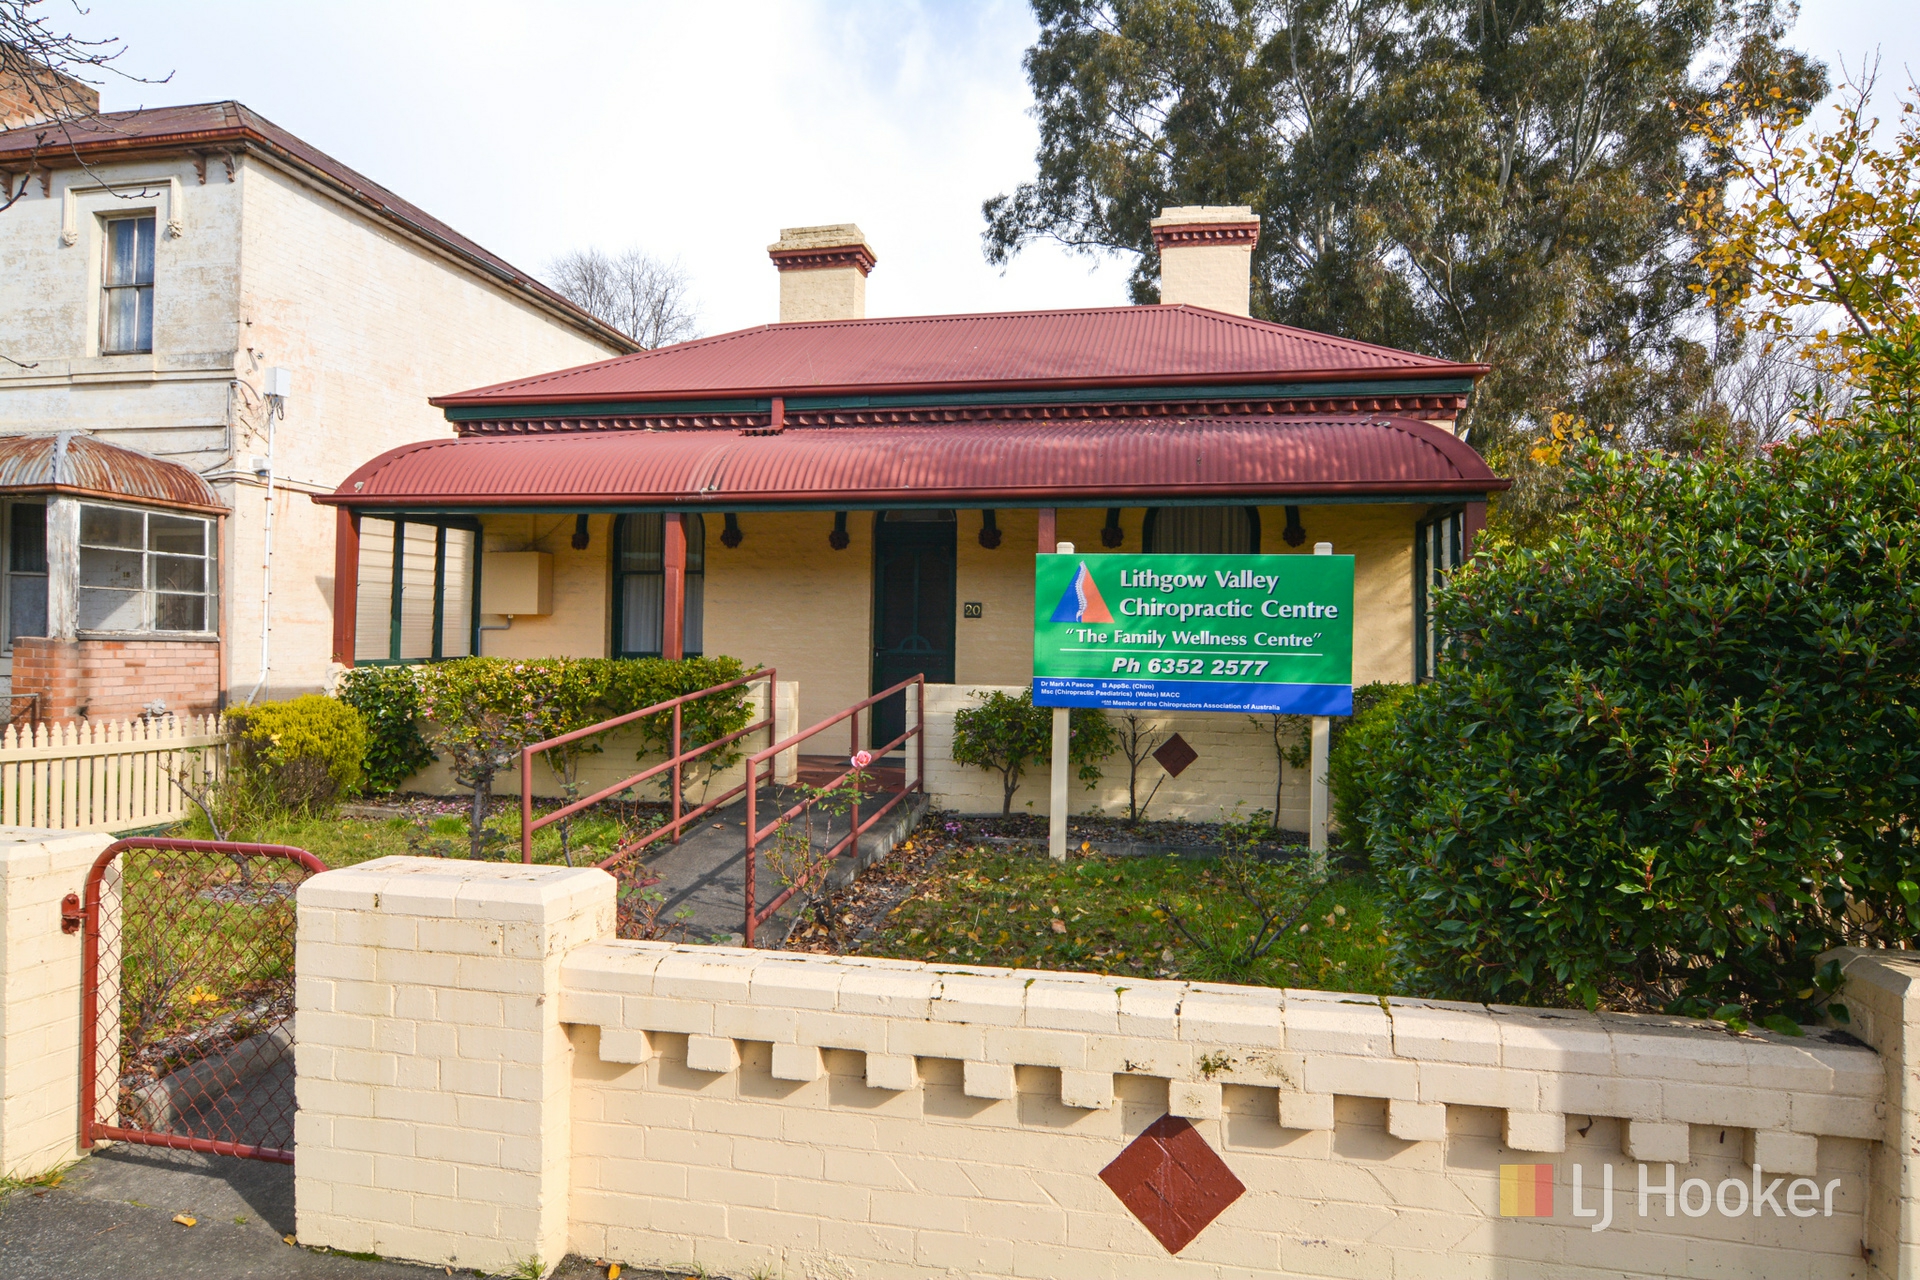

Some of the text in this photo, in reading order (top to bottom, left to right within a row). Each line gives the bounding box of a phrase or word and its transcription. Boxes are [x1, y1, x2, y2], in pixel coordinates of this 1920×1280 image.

[1120, 569, 1279, 594] Lithgow Valley
[965, 604, 981, 615] 20
[1119, 597, 1339, 622] Chiropractic Centre
[1114, 630, 1167, 648] Family
[1171, 631, 1248, 646] Wellness
[1111, 657, 1270, 676] Ph 6352 2577
[1132, 683, 1155, 691] (Chiro)
[1135, 691, 1159, 699] (Wales)
[1158, 701, 1202, 709] Chiropractors
